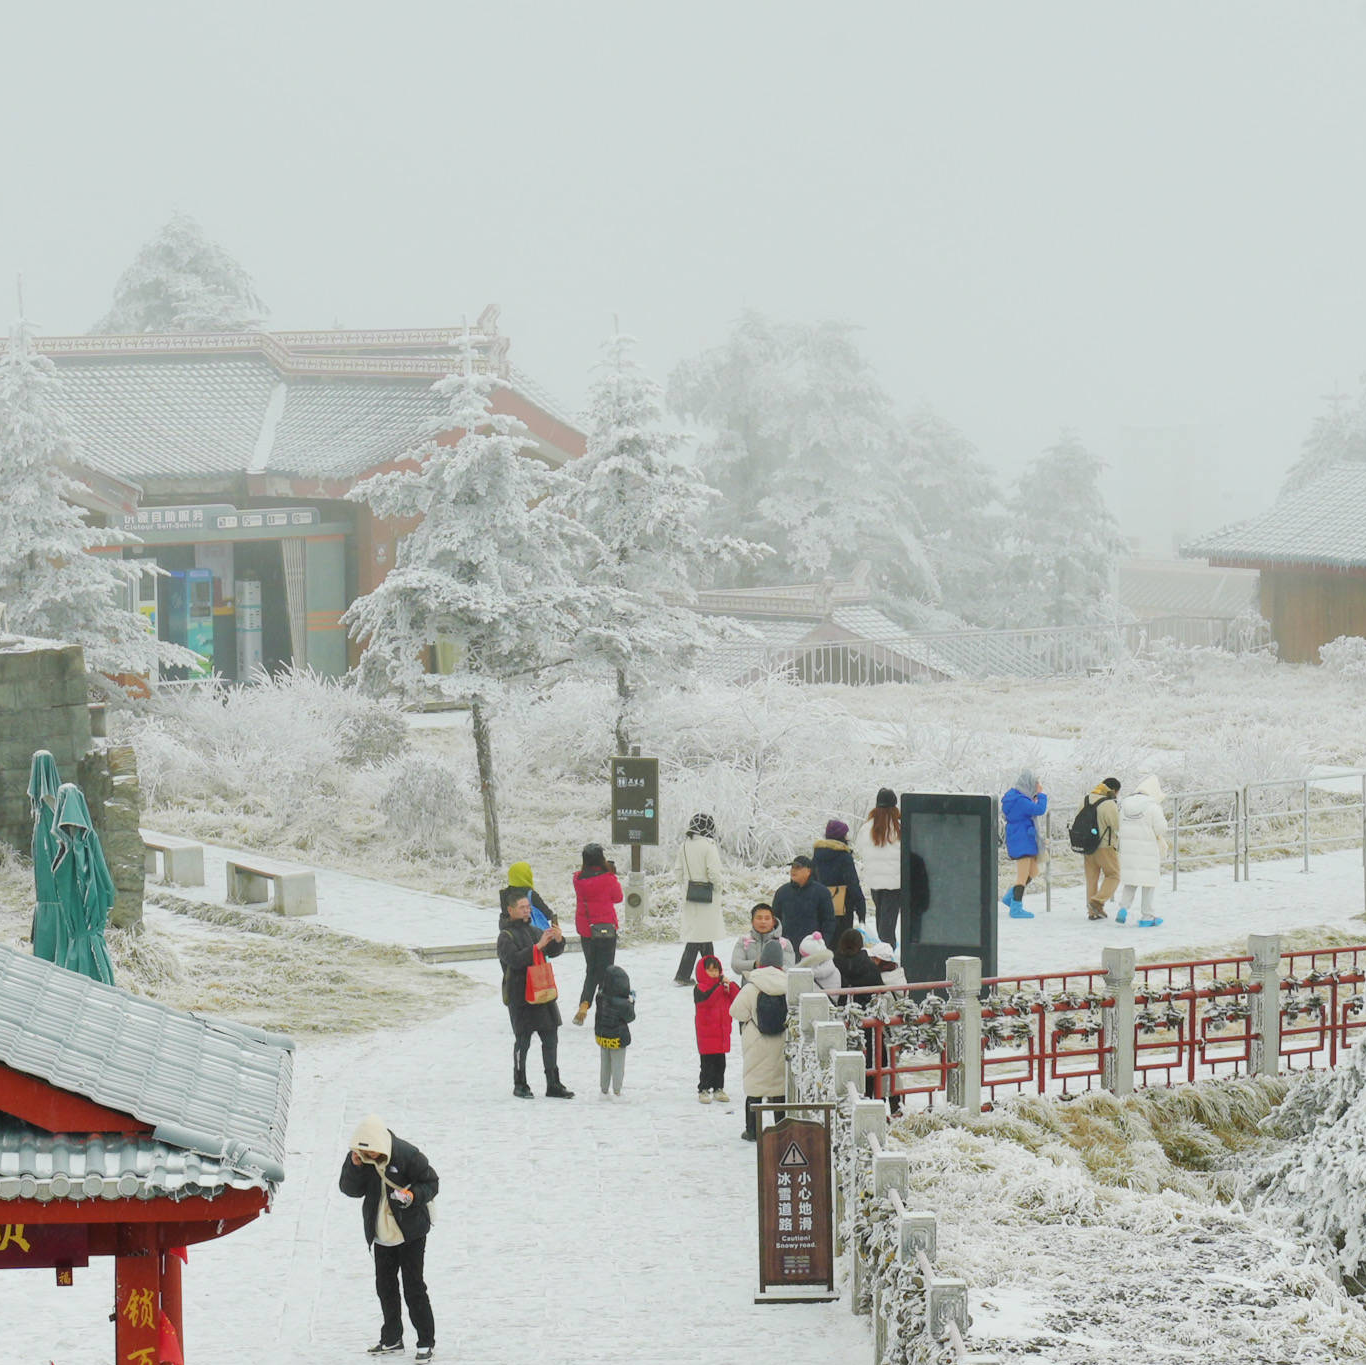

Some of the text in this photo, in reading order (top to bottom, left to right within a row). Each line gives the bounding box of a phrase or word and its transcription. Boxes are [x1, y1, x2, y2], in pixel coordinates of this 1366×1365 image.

[778, 1172, 792, 1231] 冰雪道路
[798, 1172, 812, 1230] 小心地滑
[776, 1242, 798, 1250] Snowy
[58, 1271, 72, 1285] 福
